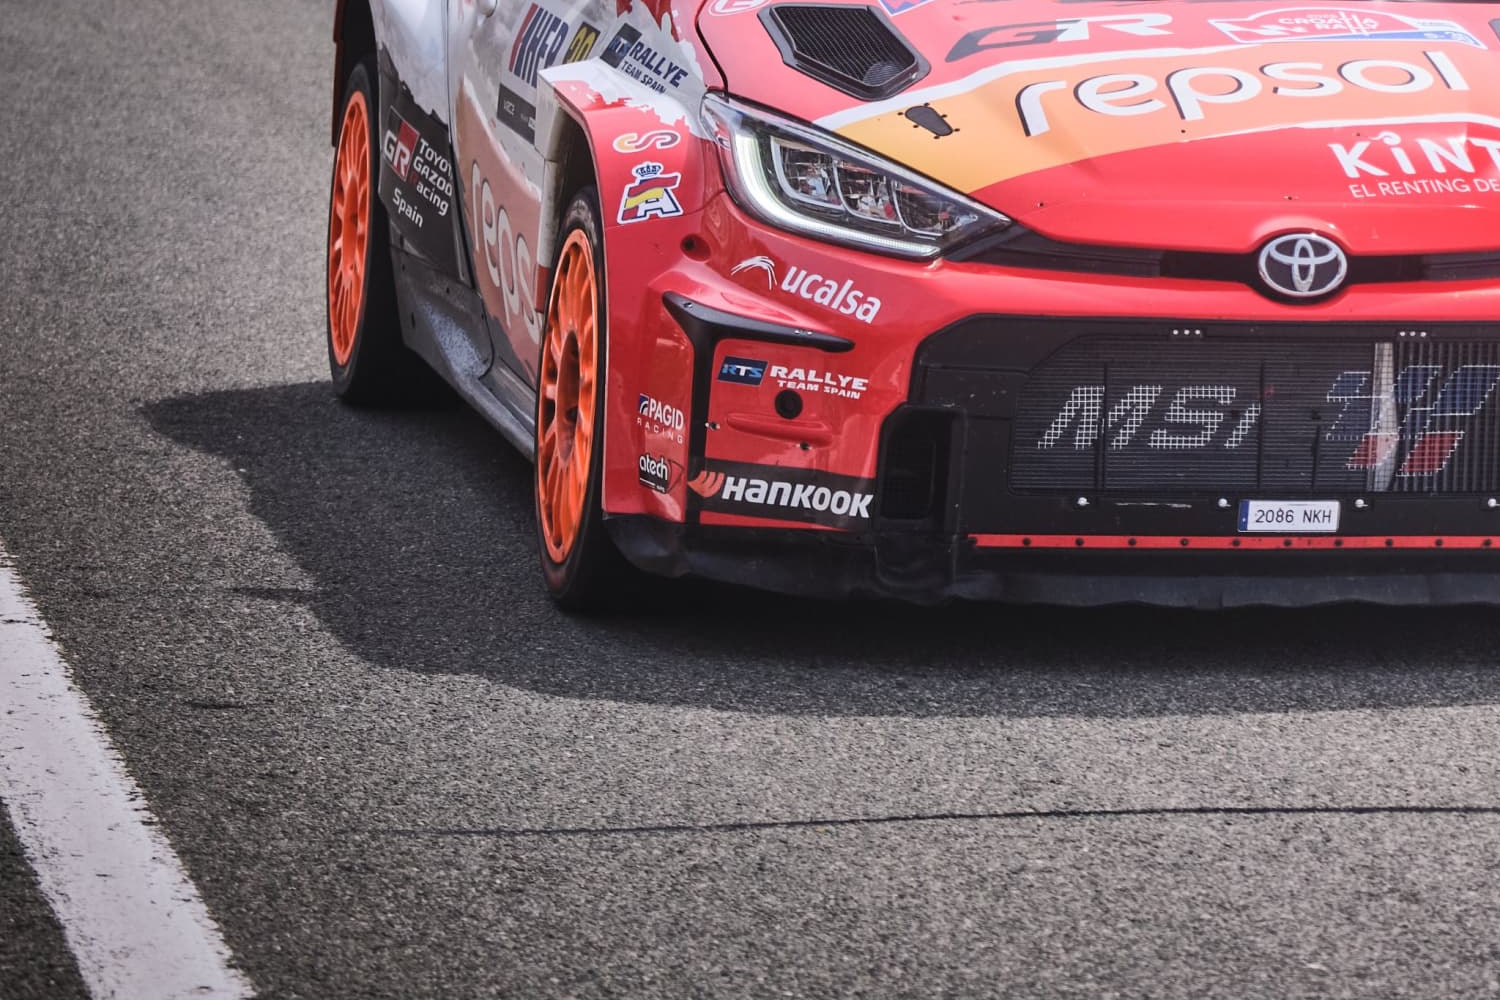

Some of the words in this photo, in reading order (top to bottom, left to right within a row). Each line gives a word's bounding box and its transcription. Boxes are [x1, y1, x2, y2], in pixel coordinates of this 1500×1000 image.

[620, 61, 642, 80] TEAM
[640, 74, 668, 94] SPAIN
[629, 41, 689, 88] RALLYE
[1015, 51, 1470, 138] repsol
[384, 130, 411, 177] GR
[420, 138, 453, 178] TOYOT
[413, 156, 453, 197] GAZOO
[1349, 184, 1377, 198] EL
[1378, 178, 1471, 197] RENTING
[393, 187, 424, 228] Spain
[781, 264, 882, 324] ucalsa
[721, 363, 764, 378] RTS
[770, 365, 869, 391] RALLYE
[777, 380, 819, 391] TEAM
[824, 386, 861, 399] SPAIN
[648, 397, 684, 431] PAGID
[636, 417, 684, 445] RACING
[639, 453, 668, 481] atech
[1255, 509, 1295, 524] 2086
[1302, 509, 1332, 524] NKH
